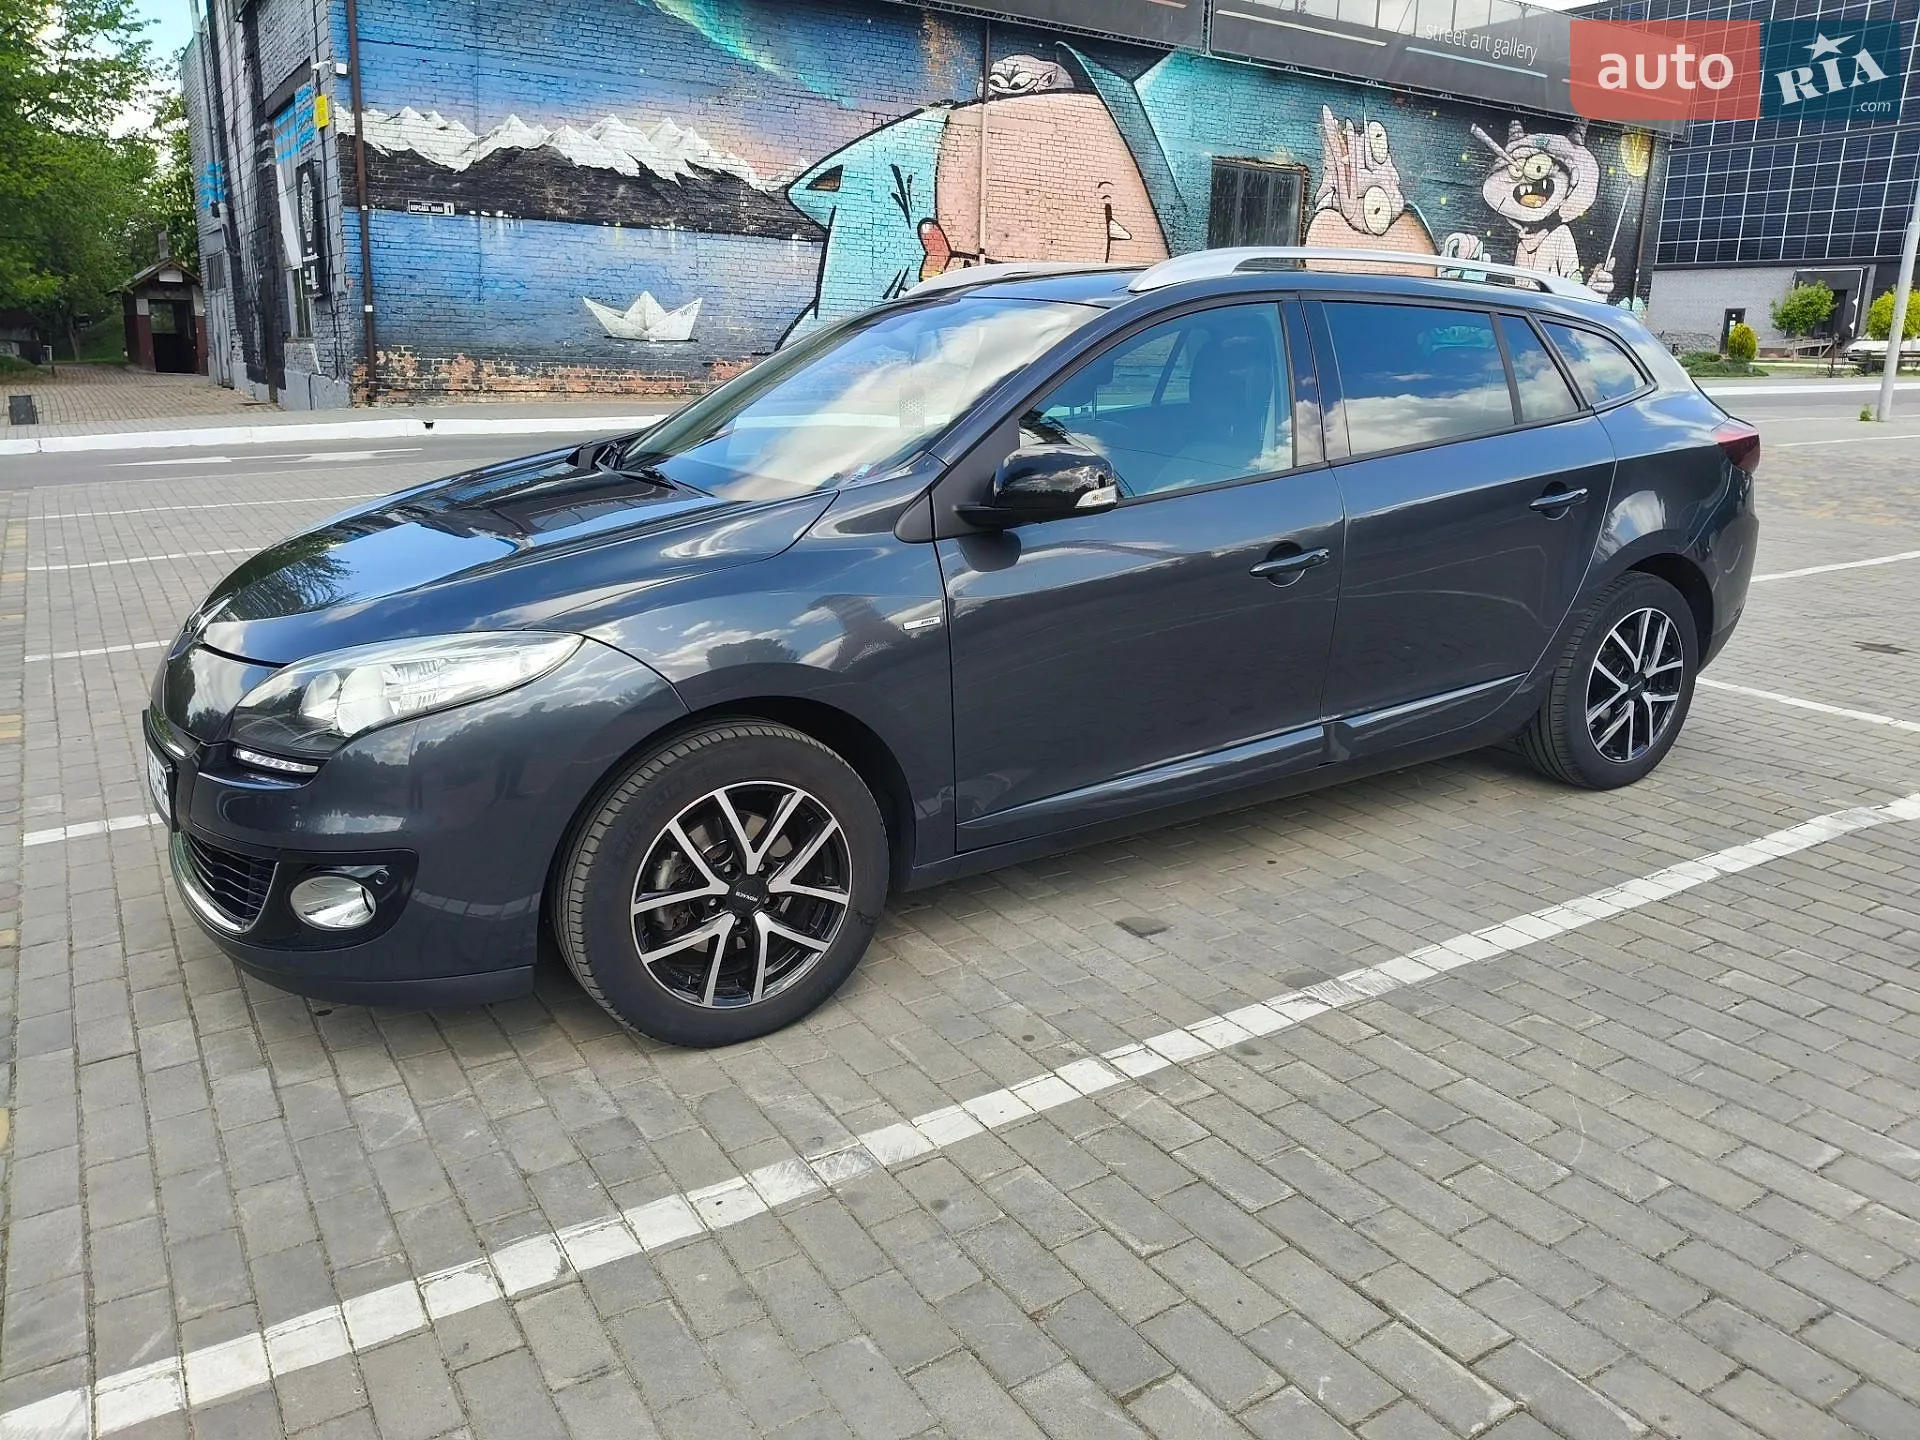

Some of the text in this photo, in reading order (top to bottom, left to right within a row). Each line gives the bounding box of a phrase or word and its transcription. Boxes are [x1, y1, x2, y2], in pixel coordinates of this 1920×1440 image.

[1425, 24, 1538, 66] street art gallery
